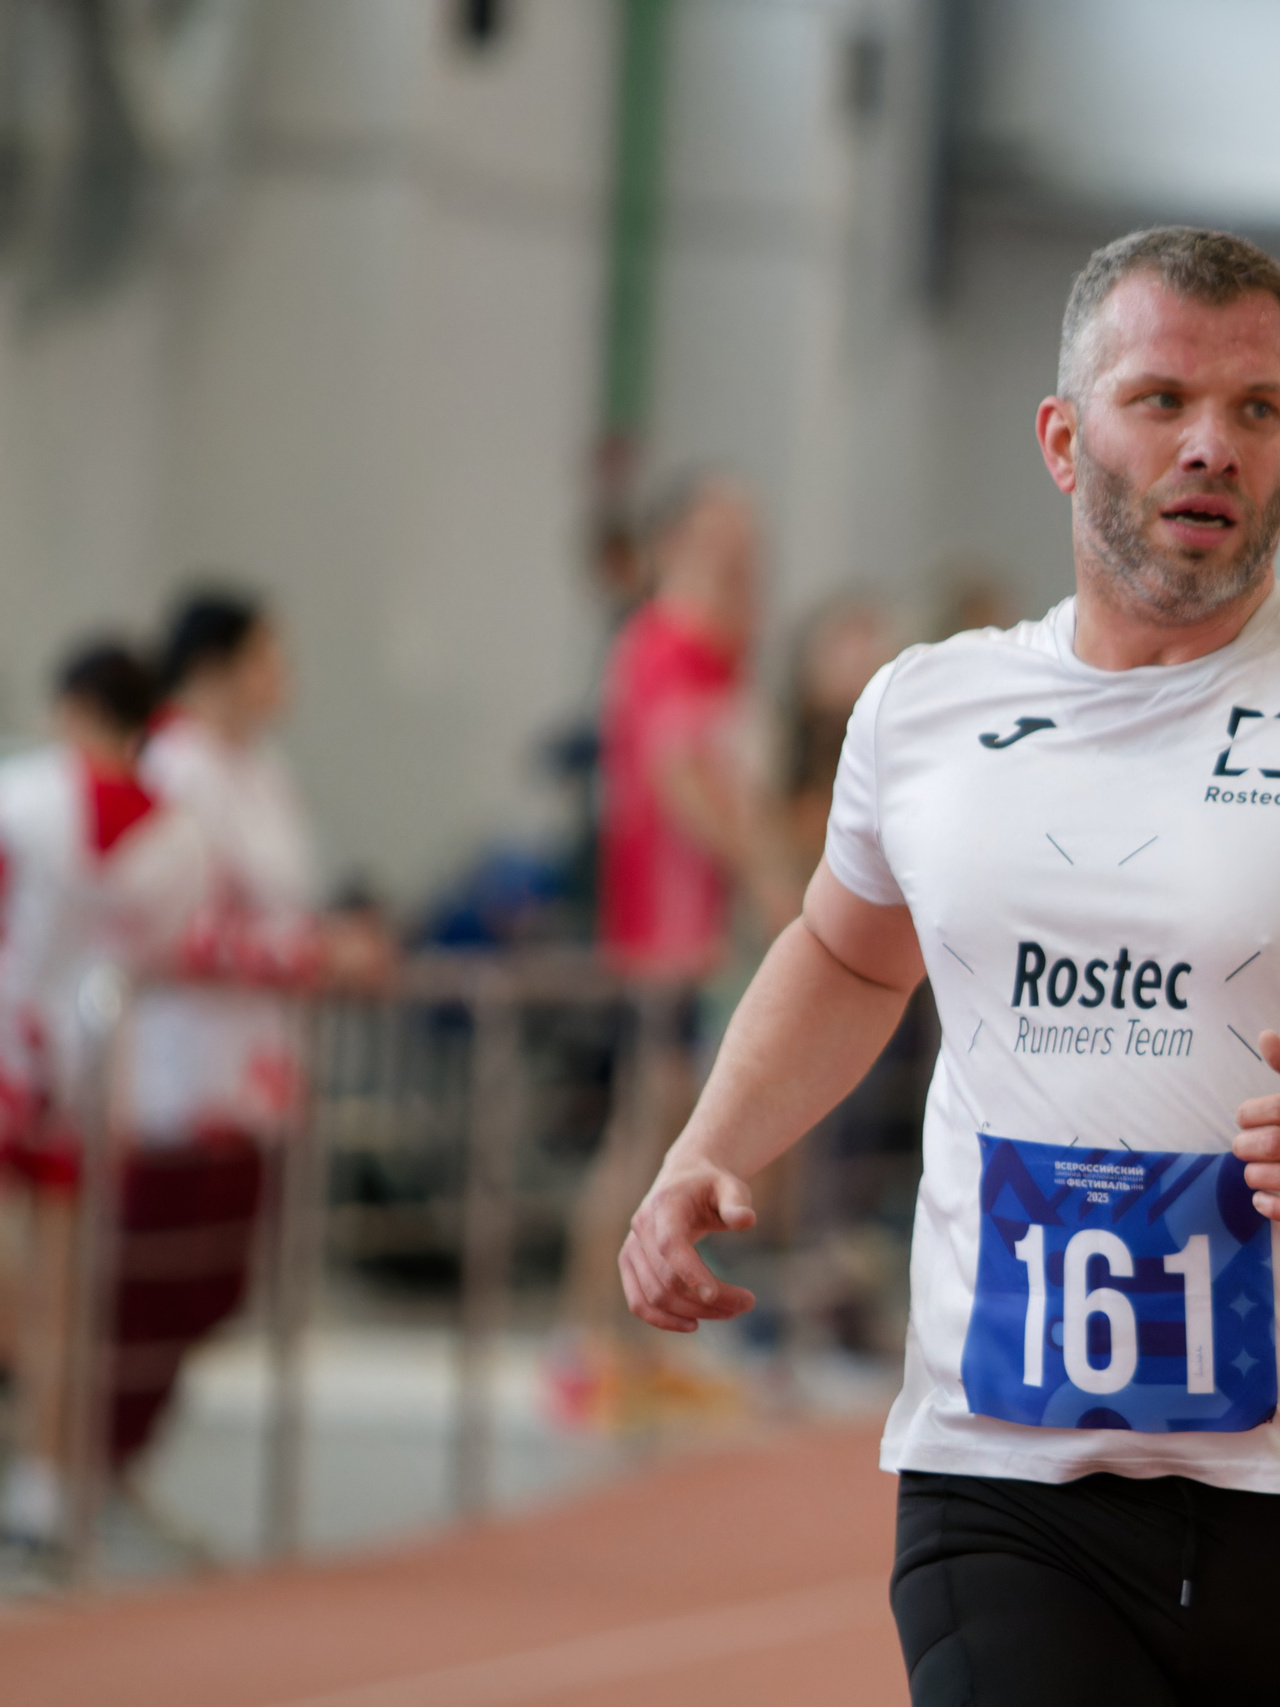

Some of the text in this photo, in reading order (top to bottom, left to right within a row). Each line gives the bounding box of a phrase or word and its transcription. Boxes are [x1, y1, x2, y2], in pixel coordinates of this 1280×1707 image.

[1011, 941, 1192, 1010] Rostec
[1015, 1016, 1193, 1057] Runners Team
[1054, 1161, 1145, 1176] ВСЕРОССИЙСКИЙ
[1066, 1178, 1131, 1191] ФЕСТИВАЛЬ
[1086, 1191, 1109, 1203] 2025
[1014, 1223, 1215, 1394] 161
